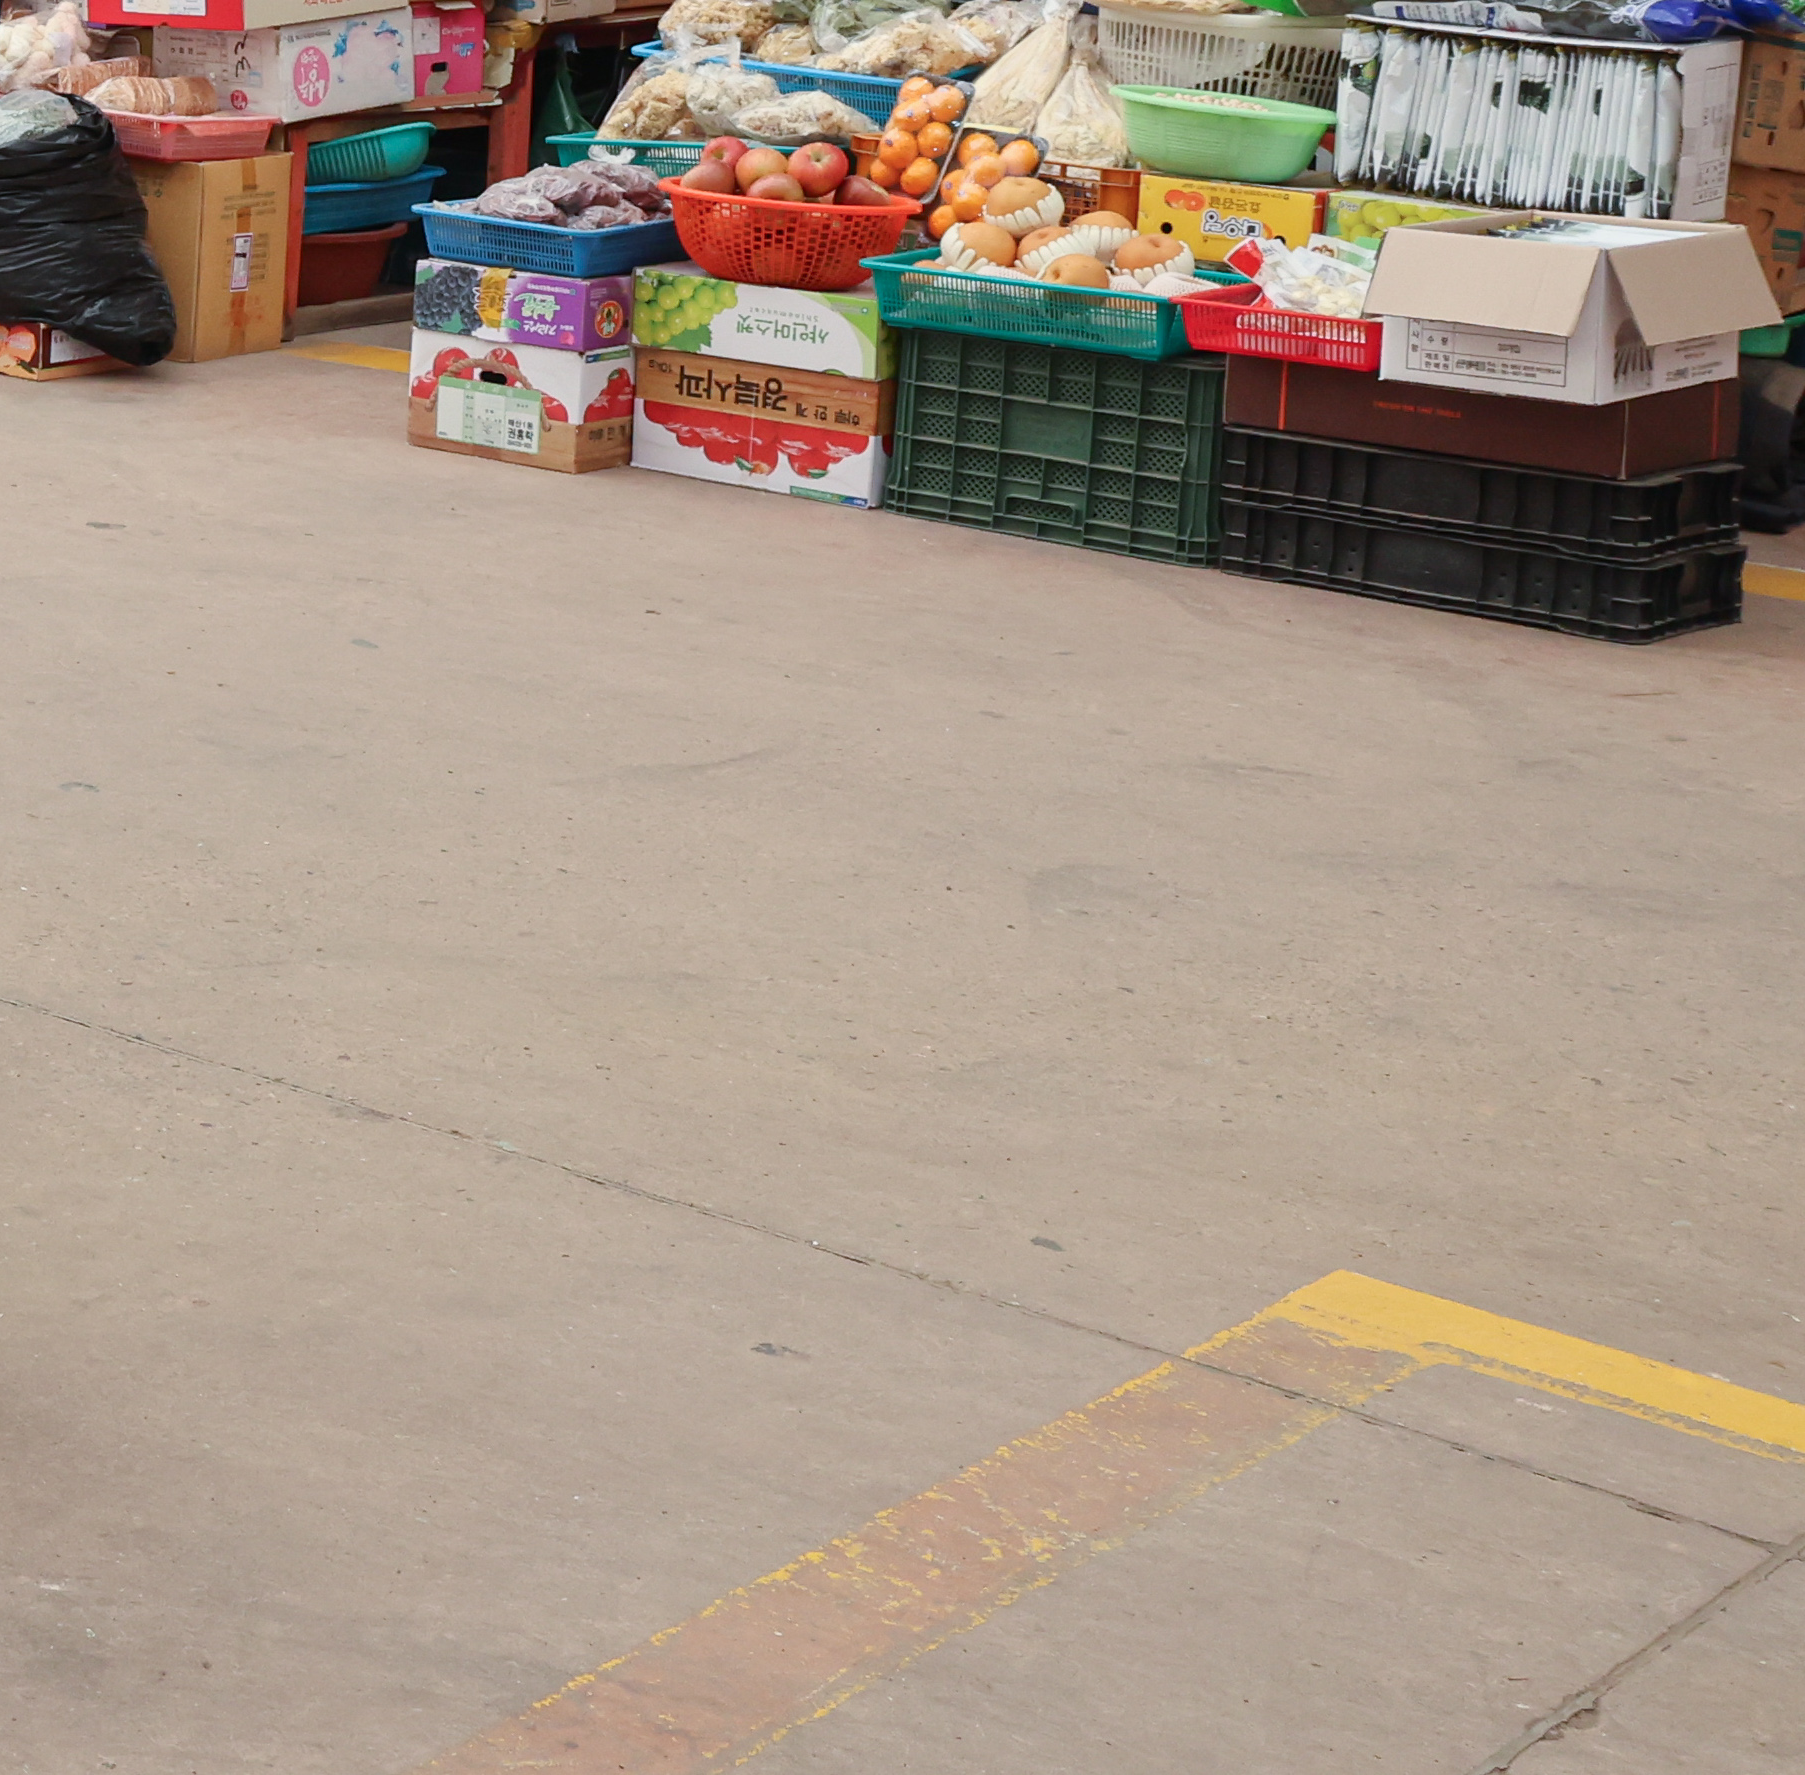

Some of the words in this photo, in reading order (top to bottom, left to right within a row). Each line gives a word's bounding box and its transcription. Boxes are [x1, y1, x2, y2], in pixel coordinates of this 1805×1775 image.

[736, 313, 830, 345] 샤인머스켓
[674, 364, 789, 412] 경북사과
[814, 405, 829, 422] 한
[834, 409, 861, 427] 하루
